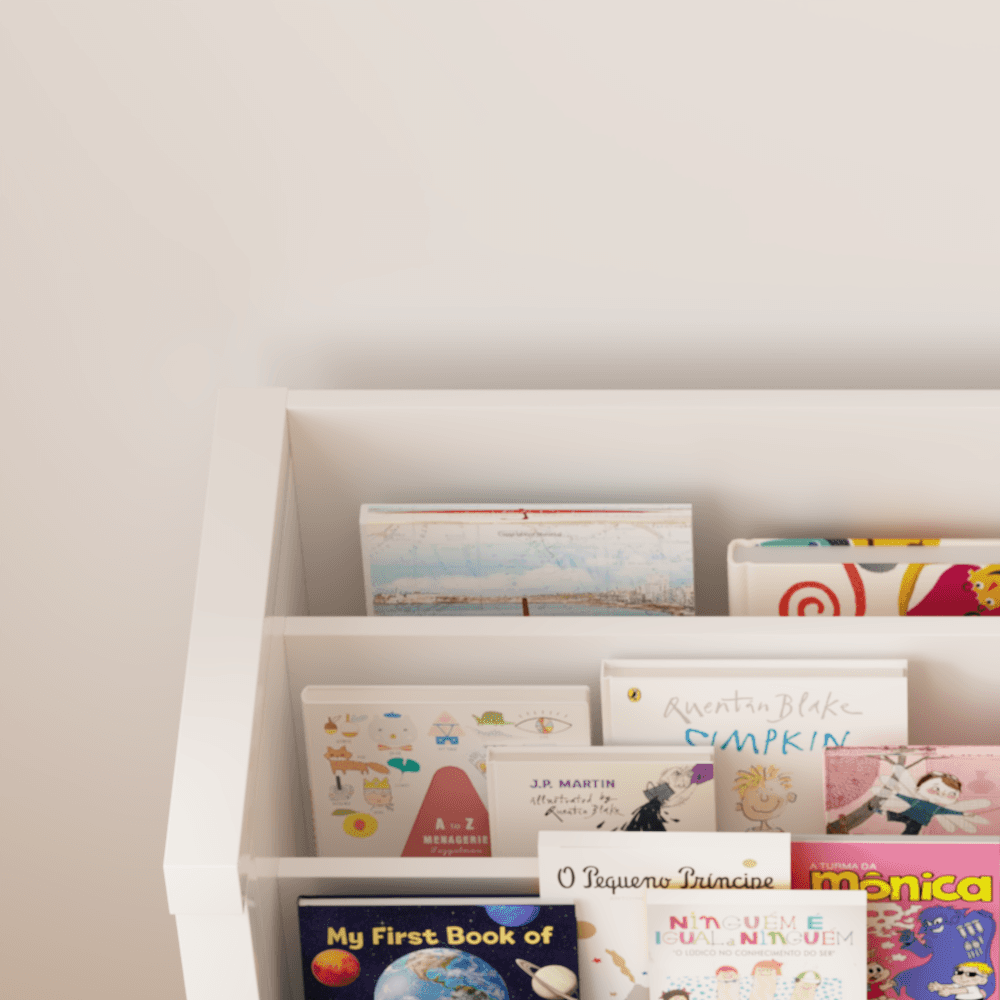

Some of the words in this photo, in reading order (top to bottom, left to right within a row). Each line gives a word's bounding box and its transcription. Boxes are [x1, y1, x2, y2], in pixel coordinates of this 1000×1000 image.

[664, 690, 768, 724] Quentin
[767, 691, 863, 723] Blake
[530, 778, 553, 788] J.P.
[559, 778, 615, 788] MARTIN
[436, 817, 445, 830] A
[465, 817, 474, 830] Z
[423, 835, 488, 844] MENAGERIE
[820, 862, 859, 870] TURMA
[861, 862, 877, 870] DA
[557, 866, 575, 889] O
[583, 866, 671, 895] Pequeno
[326, 926, 364, 950] My
[372, 926, 439, 946] First
[446, 926, 516, 946] Book
[523, 926, 554, 945] of
[655, 931, 724, 946] IGUAL
